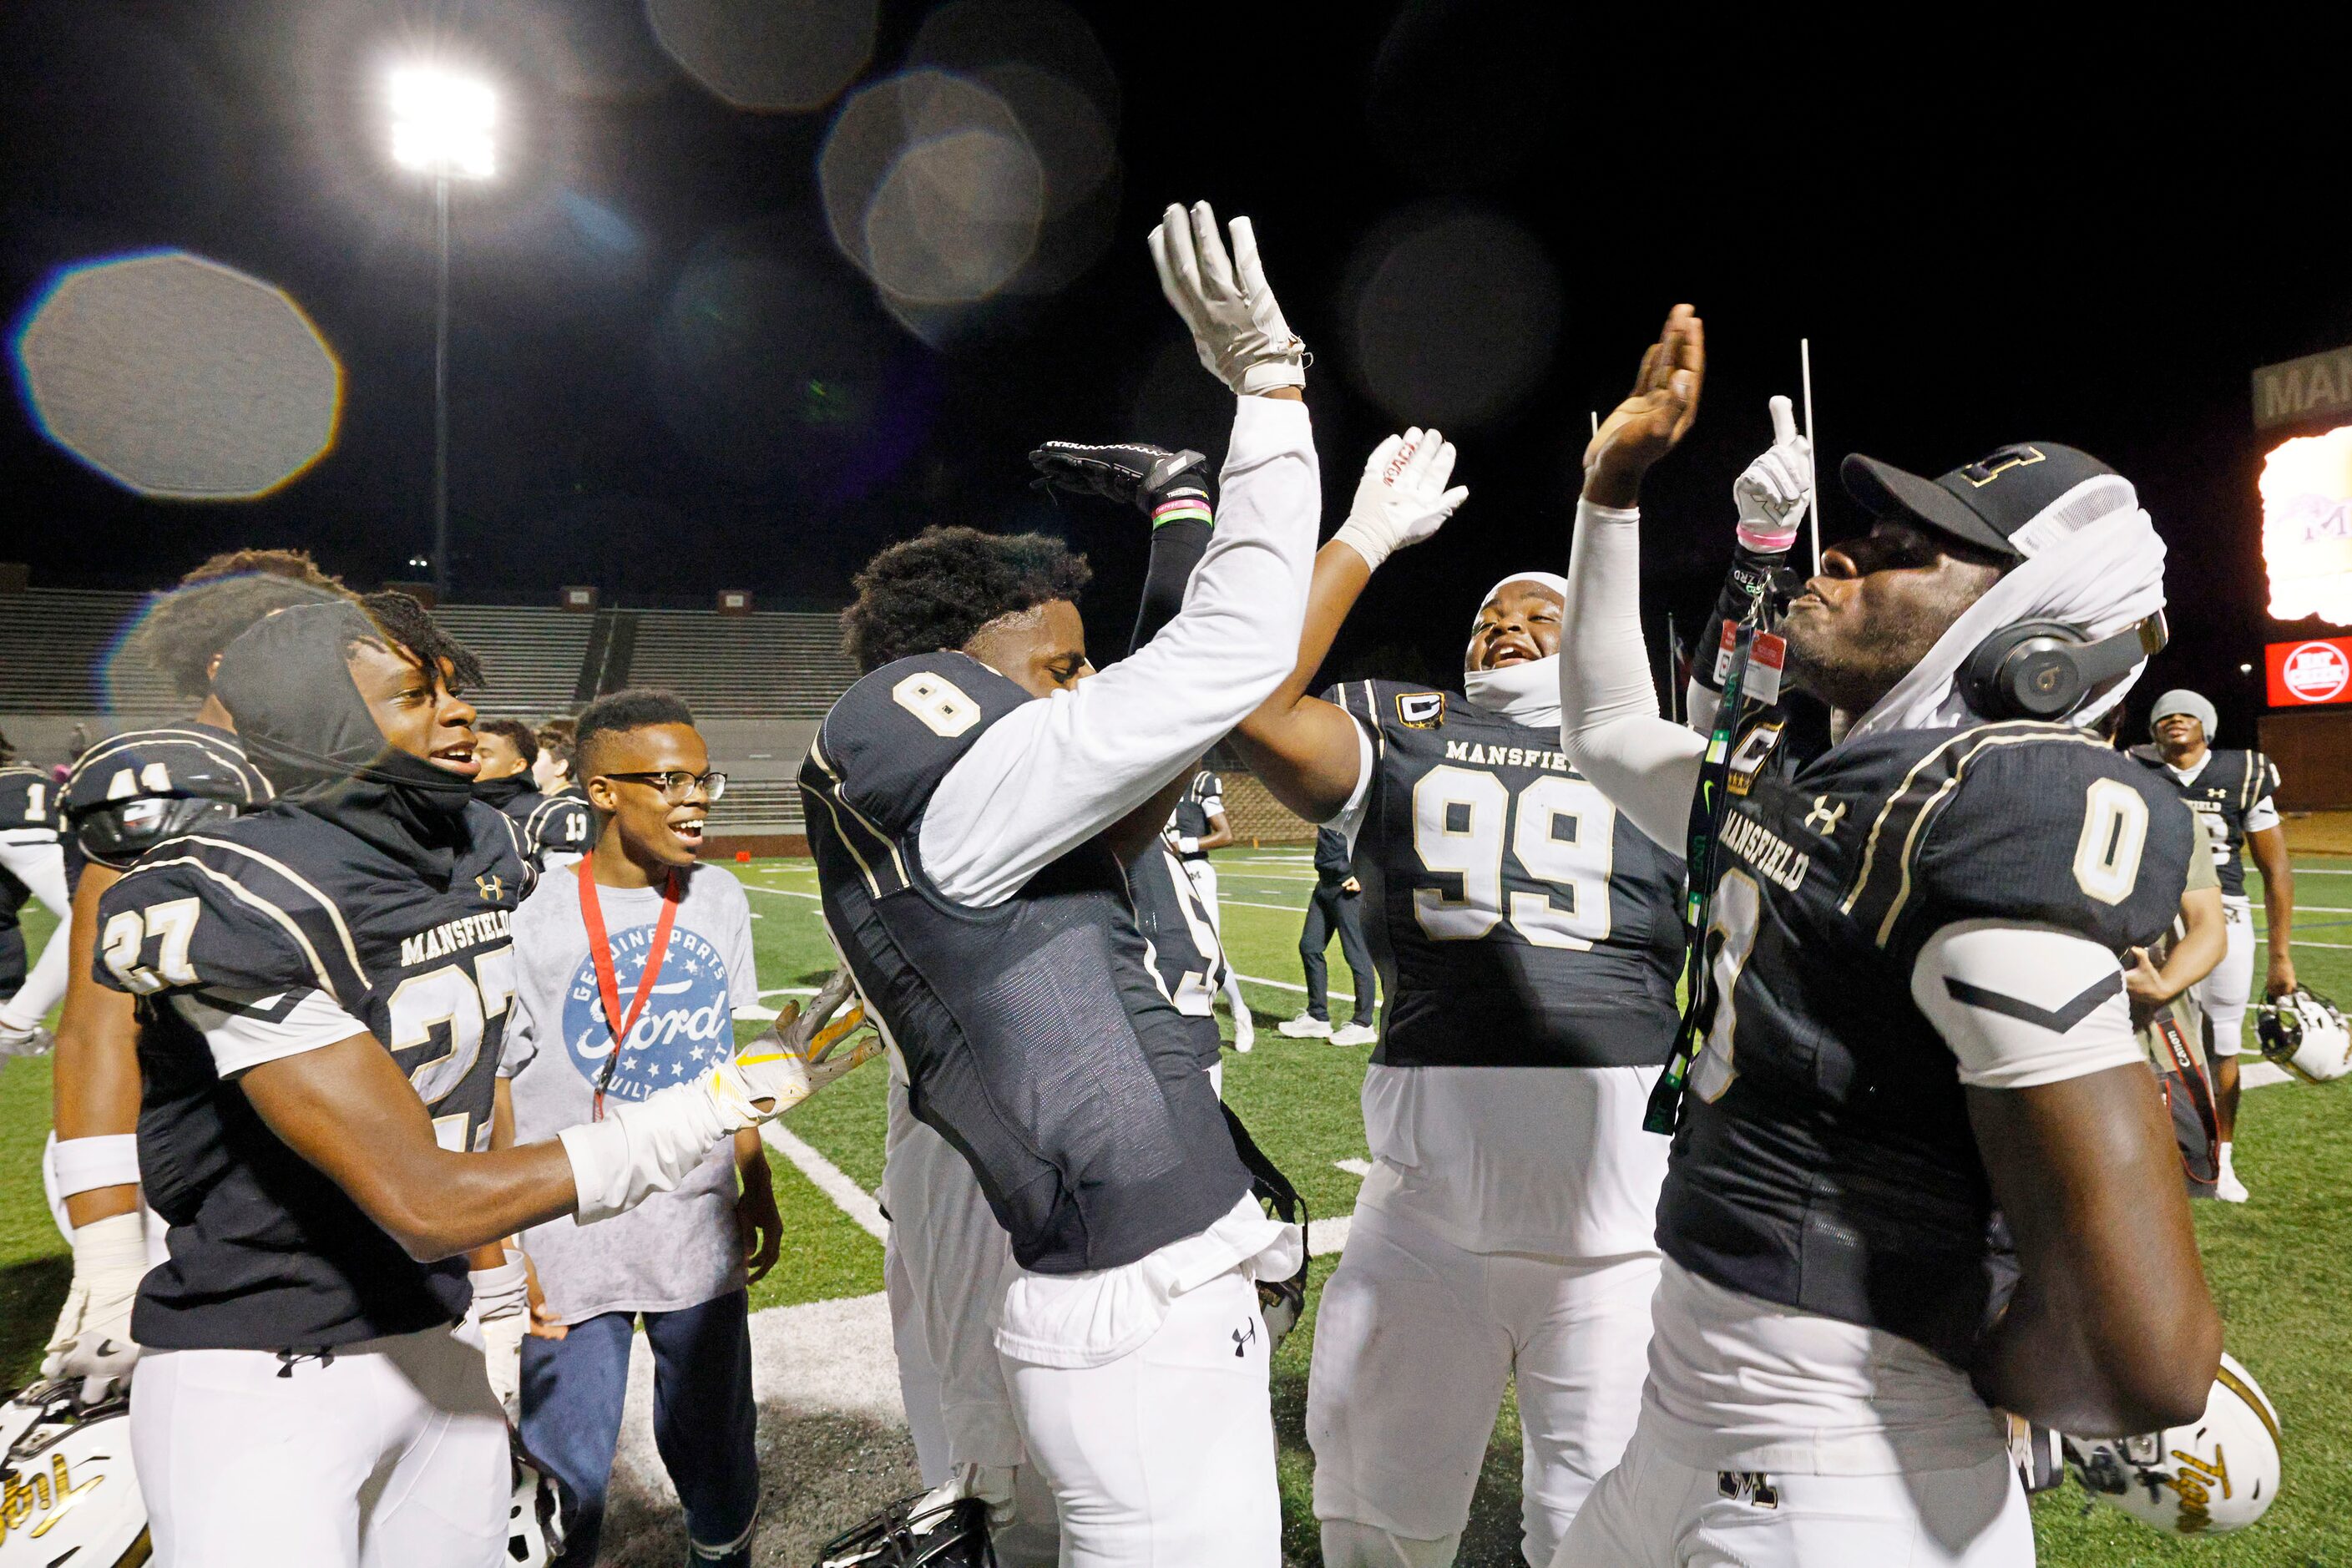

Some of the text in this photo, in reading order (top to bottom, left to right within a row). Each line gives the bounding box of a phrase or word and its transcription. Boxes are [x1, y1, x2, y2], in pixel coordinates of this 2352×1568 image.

[893, 670, 982, 738] 8
[1401, 694, 1440, 722] C
[1445, 740, 1580, 774] MANSFIE
[1730, 726, 1781, 774] C
[24, 782, 47, 822] 1
[565, 812, 587, 842] 13
[1413, 764, 1617, 952] 99
[1718, 807, 1810, 892] MANSFIELD
[2072, 776, 2149, 907] 0
[102, 896, 202, 996] 27
[401, 908, 511, 968] MANSFIELD
[669, 928, 726, 980] PARTS
[387, 943, 515, 1153] 27
[575, 979, 727, 1060] Ford
[2167, 1029, 2191, 1068] Canon
